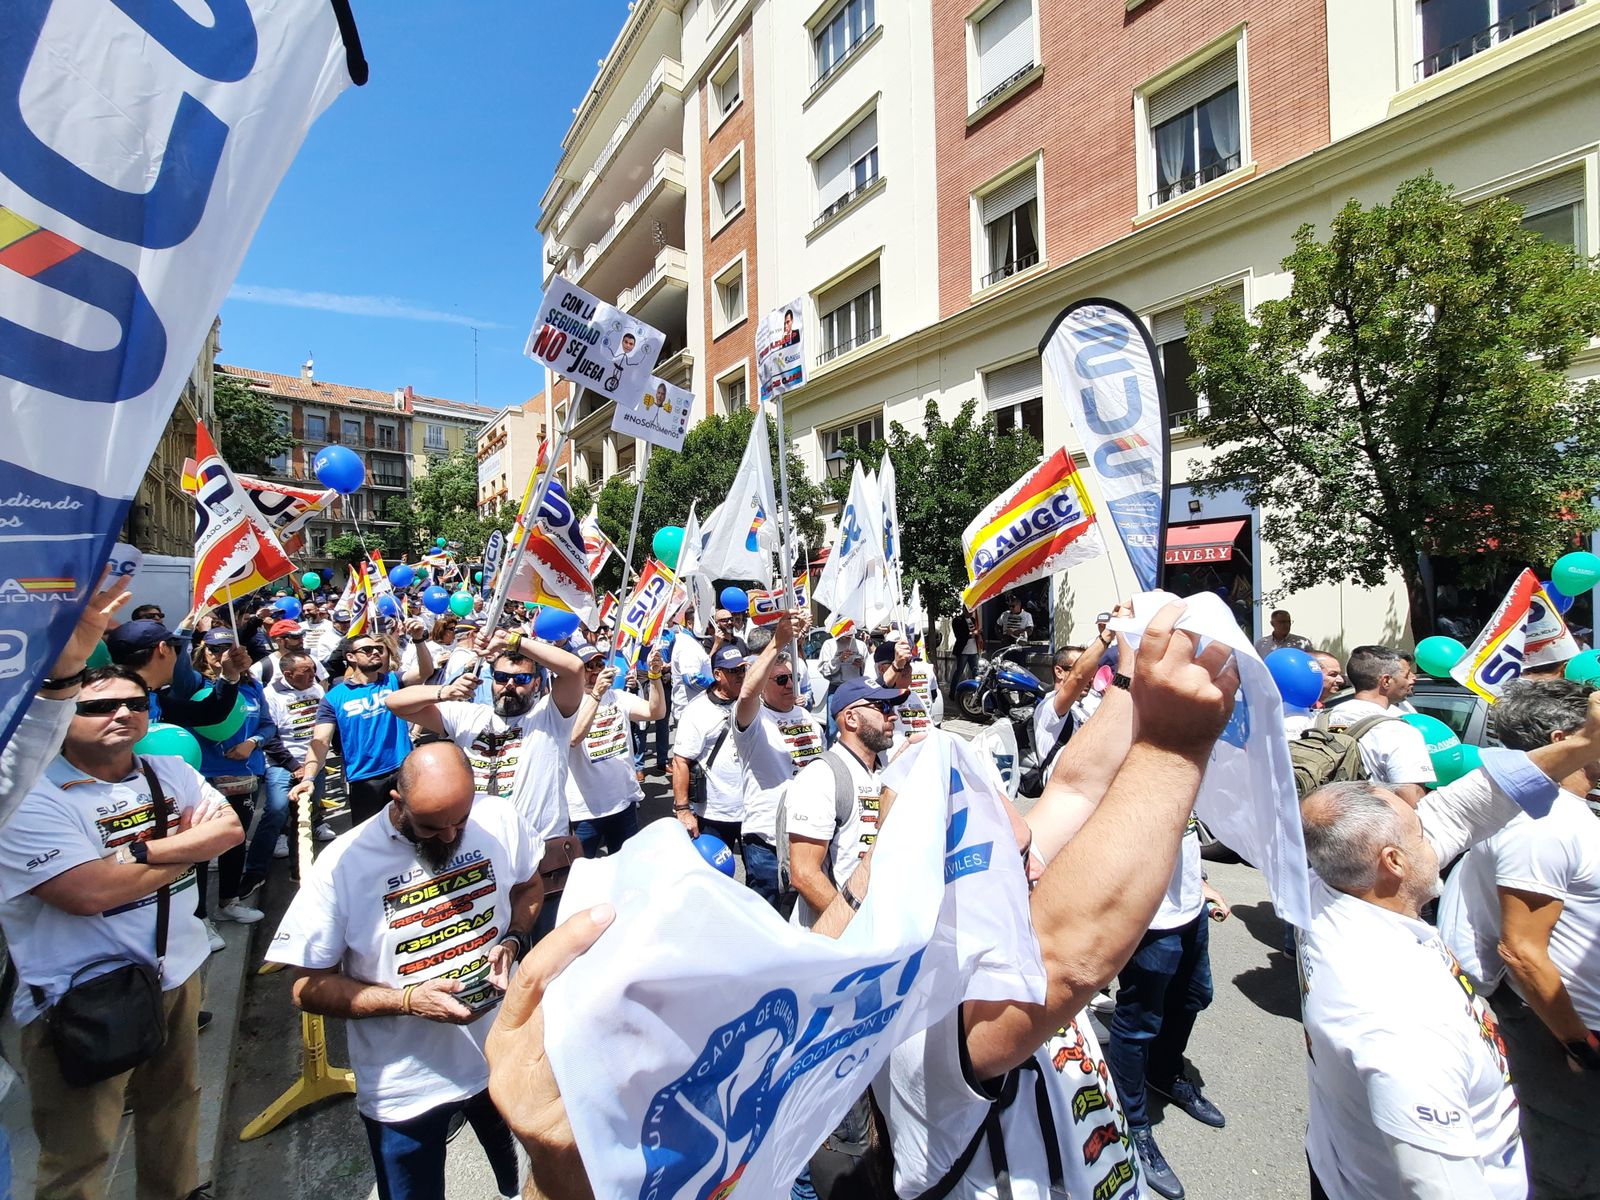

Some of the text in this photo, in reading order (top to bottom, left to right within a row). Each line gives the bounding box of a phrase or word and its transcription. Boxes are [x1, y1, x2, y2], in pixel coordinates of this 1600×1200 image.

[561, 292, 597, 322] CON LA
[532, 324, 584, 362] NO SE
[546, 308, 600, 346] SEGURIDAD
[567, 344, 606, 382] JUEGA
[996, 494, 1073, 557] AUGC
[550, 529, 586, 565] UNIFICADO
[1165, 548, 1228, 562] LIVERY
[97, 800, 128, 816] SUP
[26, 849, 60, 872] SUP
[388, 868, 424, 890] SUP
[400, 869, 482, 905] #DIETAS
[398, 910, 494, 952] #35HORAS
[399, 928, 498, 974] #SEXTOTURNO
[755, 1001, 771, 1027] DE
[1416, 1106, 1460, 1125] SUP
